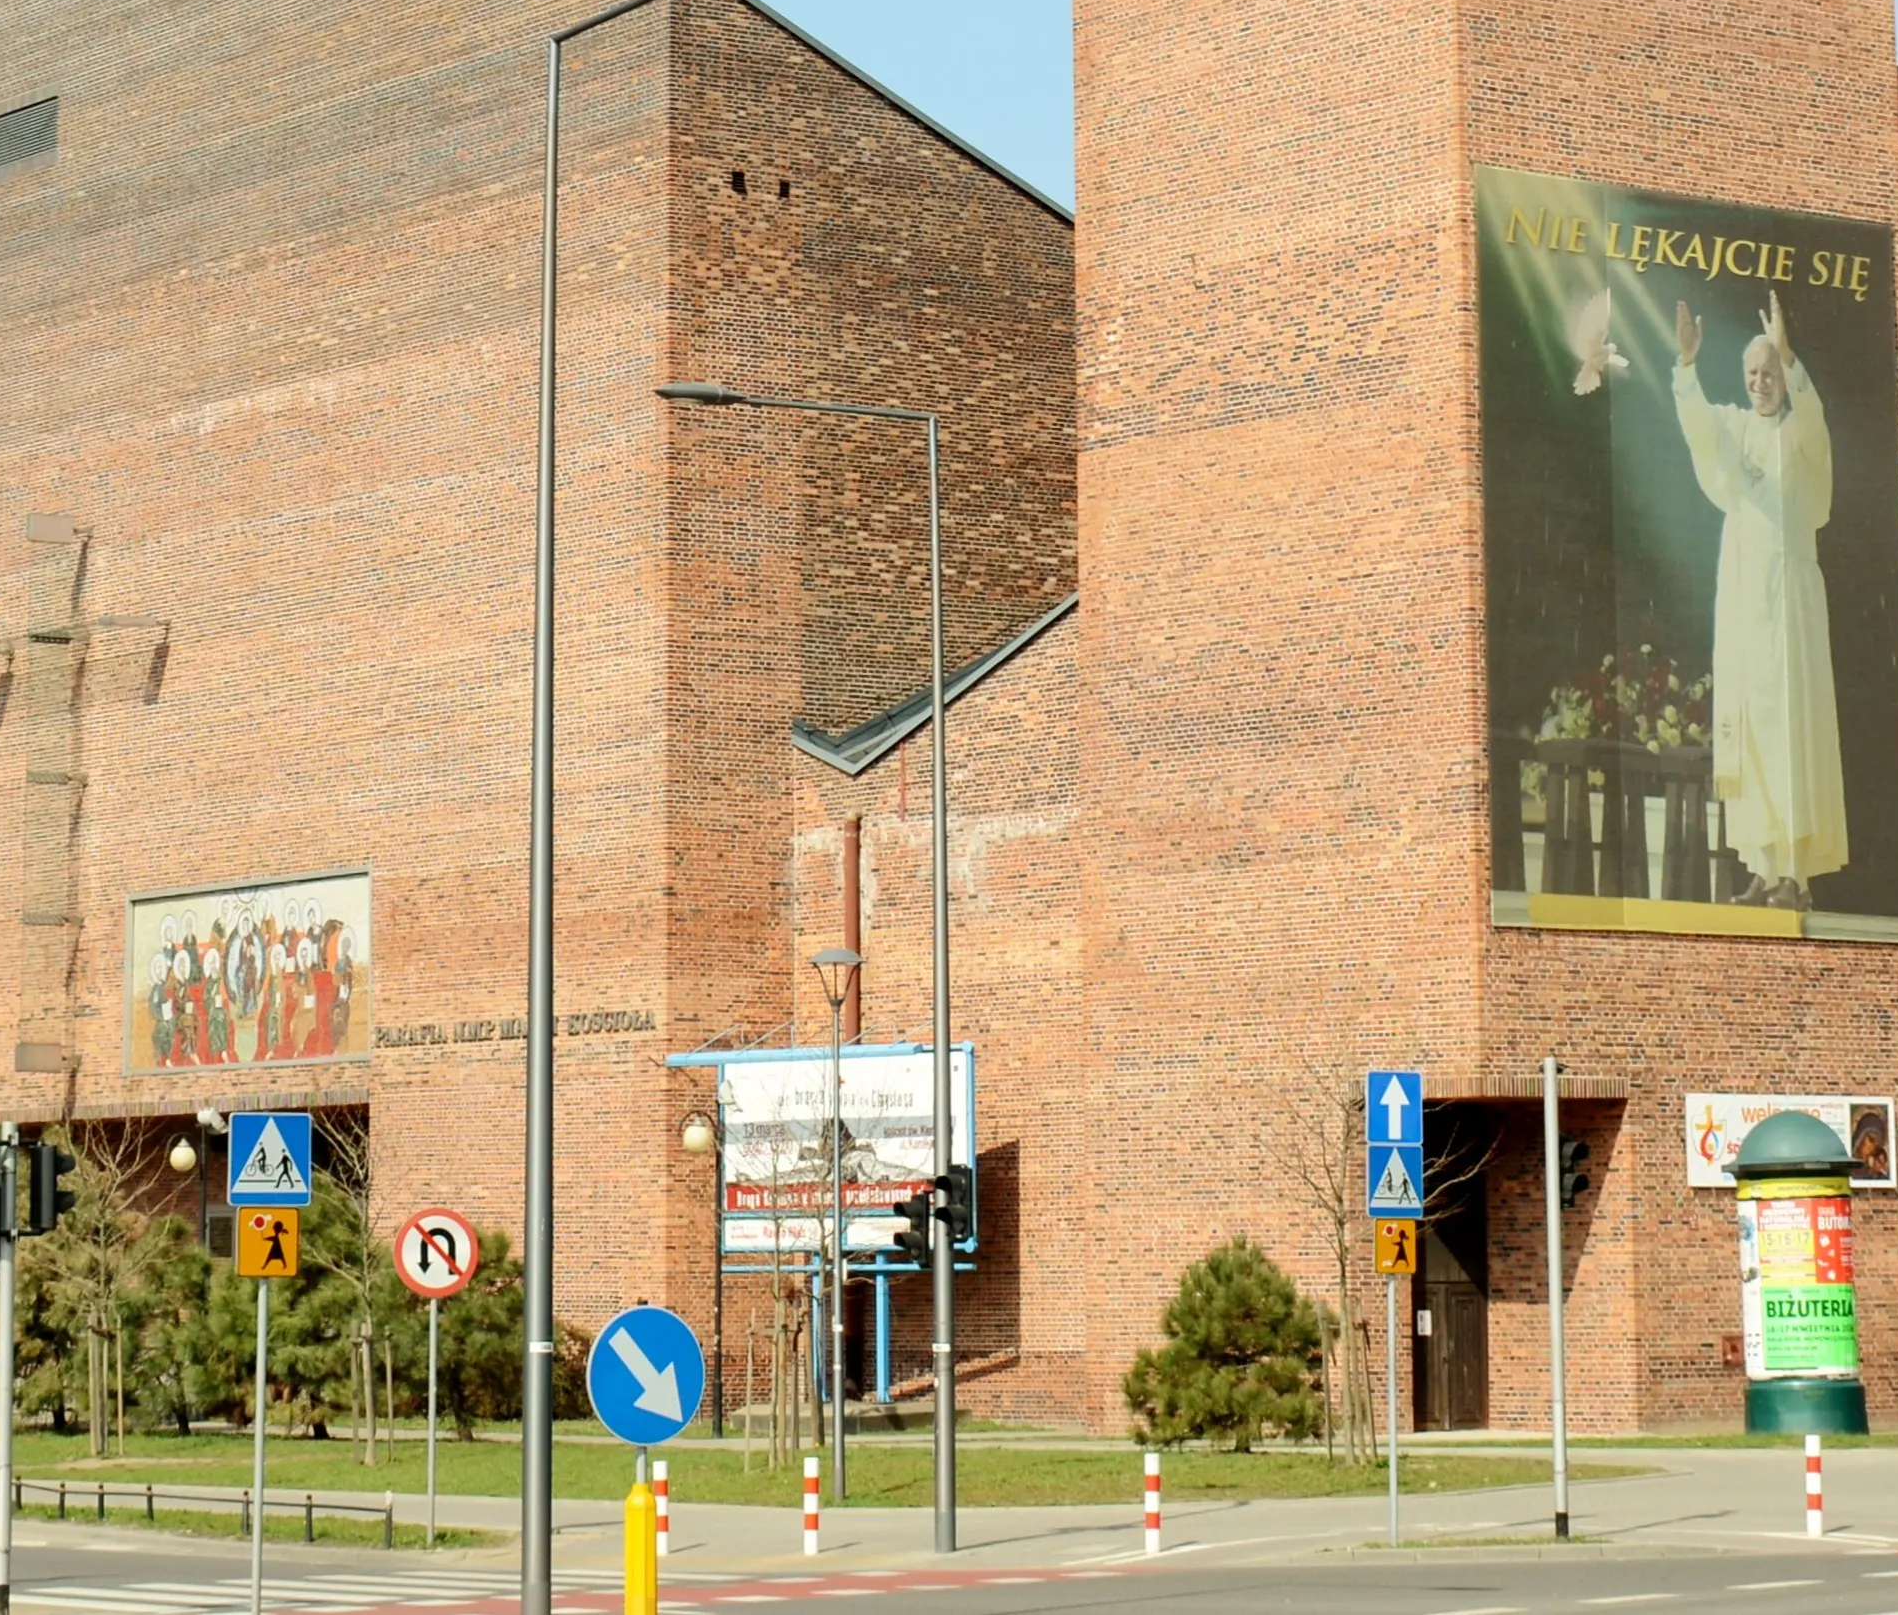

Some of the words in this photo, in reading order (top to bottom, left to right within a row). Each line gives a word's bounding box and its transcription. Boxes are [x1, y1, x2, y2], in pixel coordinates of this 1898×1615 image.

[1505, 205, 1589, 254] NIE
[1605, 221, 1796, 282] LĘKAJCIE
[1808, 250, 1871, 302] SIĘ
[374, 1025, 448, 1048] PARAFIA
[1741, 1102, 1822, 1123] wele
[1765, 1293, 1854, 1318] BIŻUTERIA
